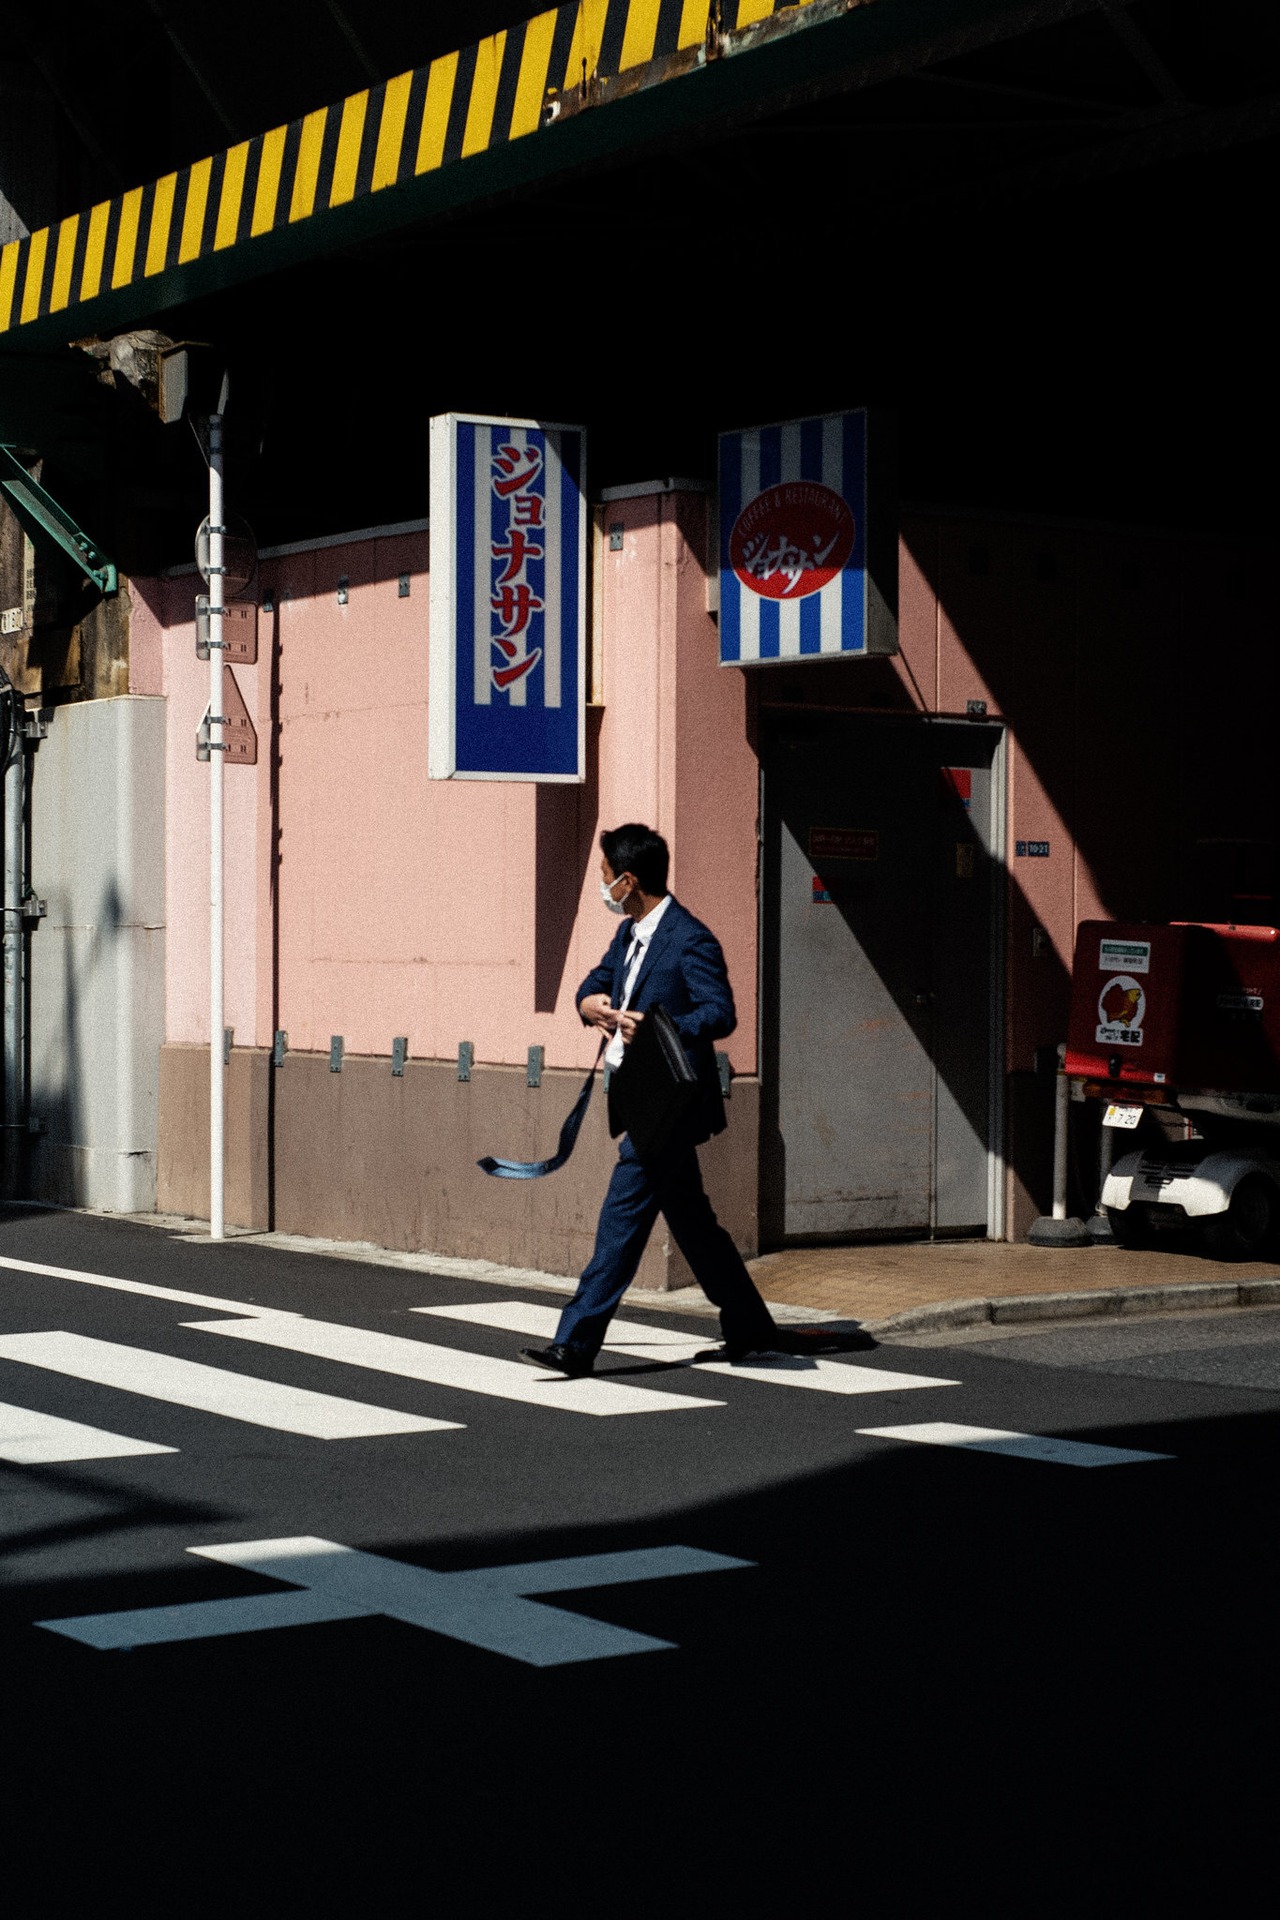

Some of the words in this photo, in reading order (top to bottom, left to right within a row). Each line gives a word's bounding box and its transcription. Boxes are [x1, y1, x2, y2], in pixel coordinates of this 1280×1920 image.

[737, 496, 771, 538] COFFEE
[785, 487, 847, 524] RESTAURANT
[491, 444, 544, 690] ジョナサン
[742, 527, 840, 594] ジョナサン
